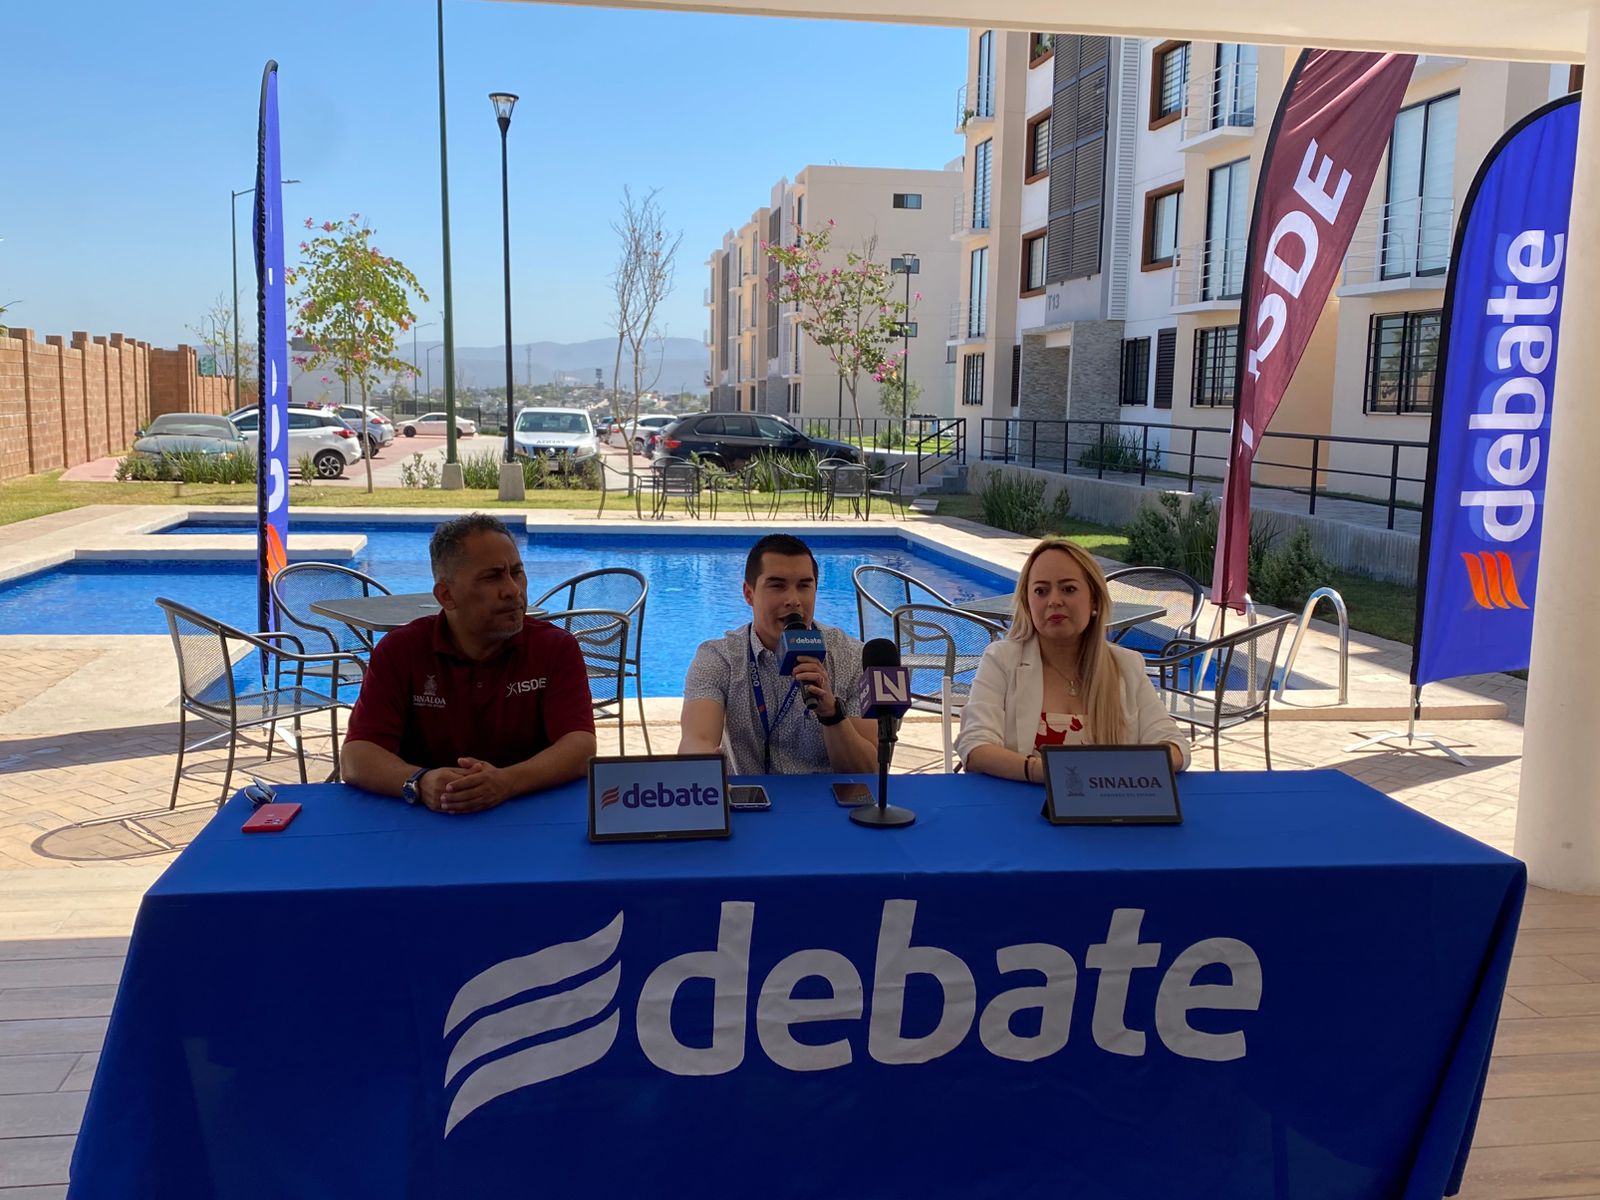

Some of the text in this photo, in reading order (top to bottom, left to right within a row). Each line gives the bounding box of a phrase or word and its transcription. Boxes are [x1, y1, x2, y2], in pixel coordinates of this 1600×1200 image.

[1460, 229, 1565, 542] debate
[517, 677, 547, 693] ISDE
[412, 694, 447, 705] SINALOA
[1088, 776, 1162, 789] SINALOA
[622, 782, 719, 809] debate
[635, 900, 1264, 1077] debate
